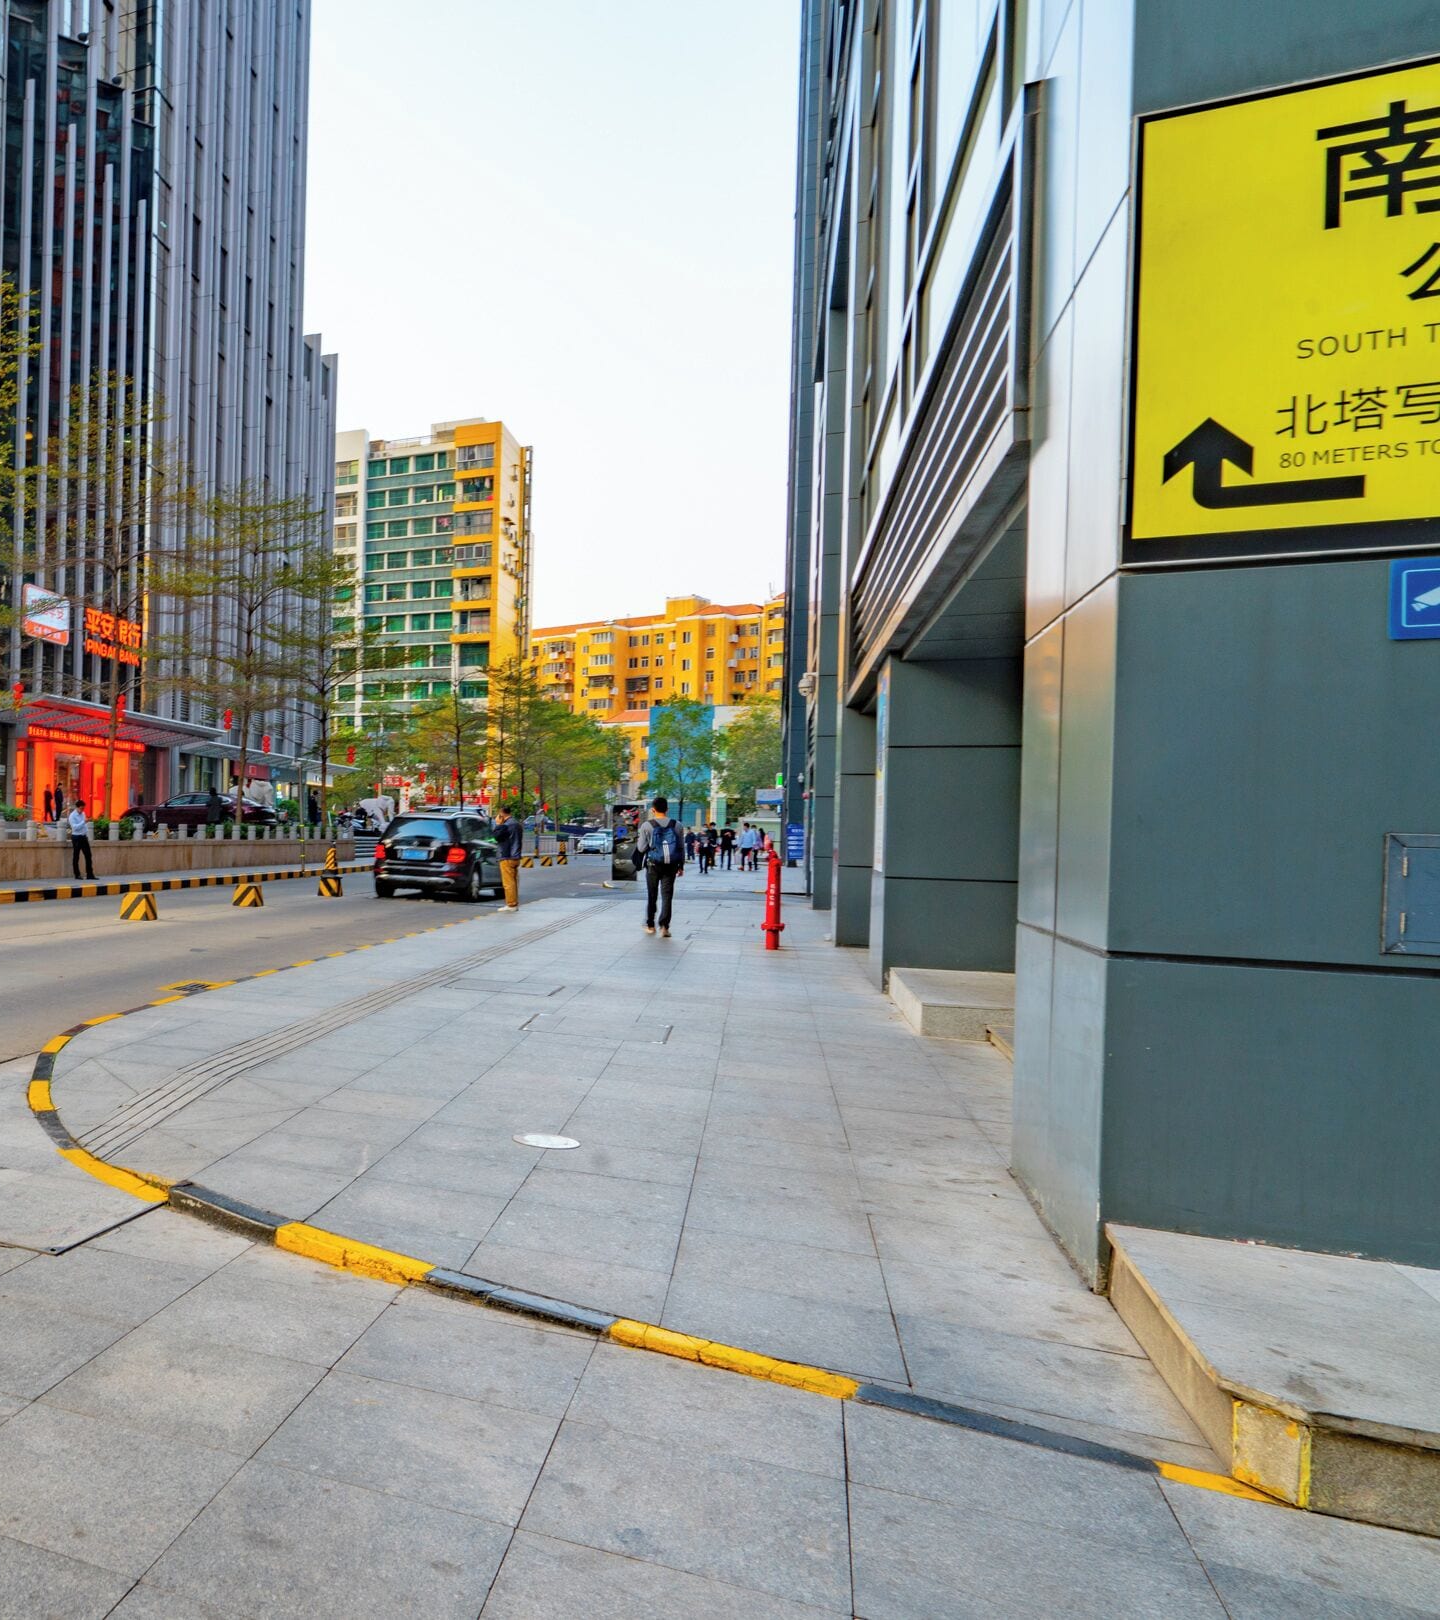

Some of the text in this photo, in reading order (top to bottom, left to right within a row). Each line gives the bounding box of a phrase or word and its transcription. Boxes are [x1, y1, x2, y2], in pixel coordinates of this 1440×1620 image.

[1316, 99, 1440, 230] 南
[1297, 327, 1407, 359] SOUTH
[1275, 382, 1440, 438] 北塔写
[1280, 453, 1306, 469] 80
[1312, 442, 1409, 466] METERS
